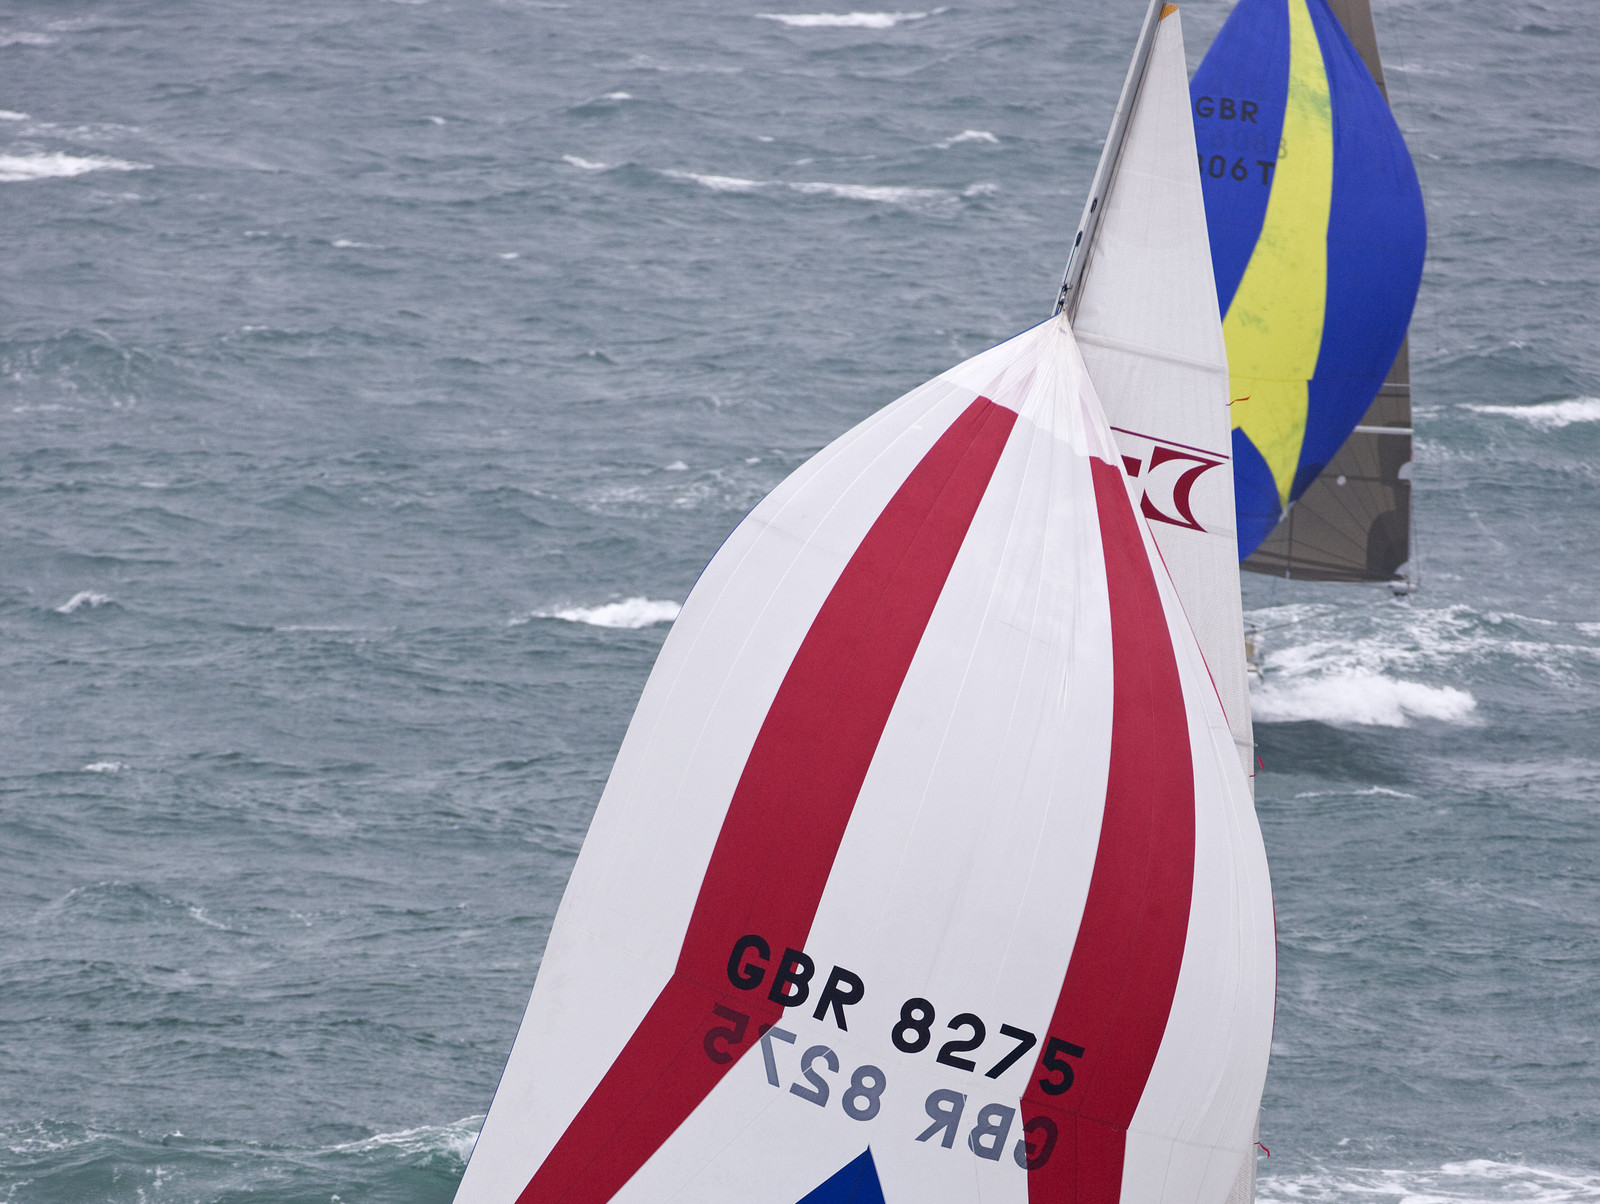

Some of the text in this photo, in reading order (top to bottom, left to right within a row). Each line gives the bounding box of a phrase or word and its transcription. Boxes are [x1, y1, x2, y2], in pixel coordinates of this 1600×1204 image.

[1195, 96, 1258, 124] GBR
[726, 934, 1086, 1096] GBR 8275
